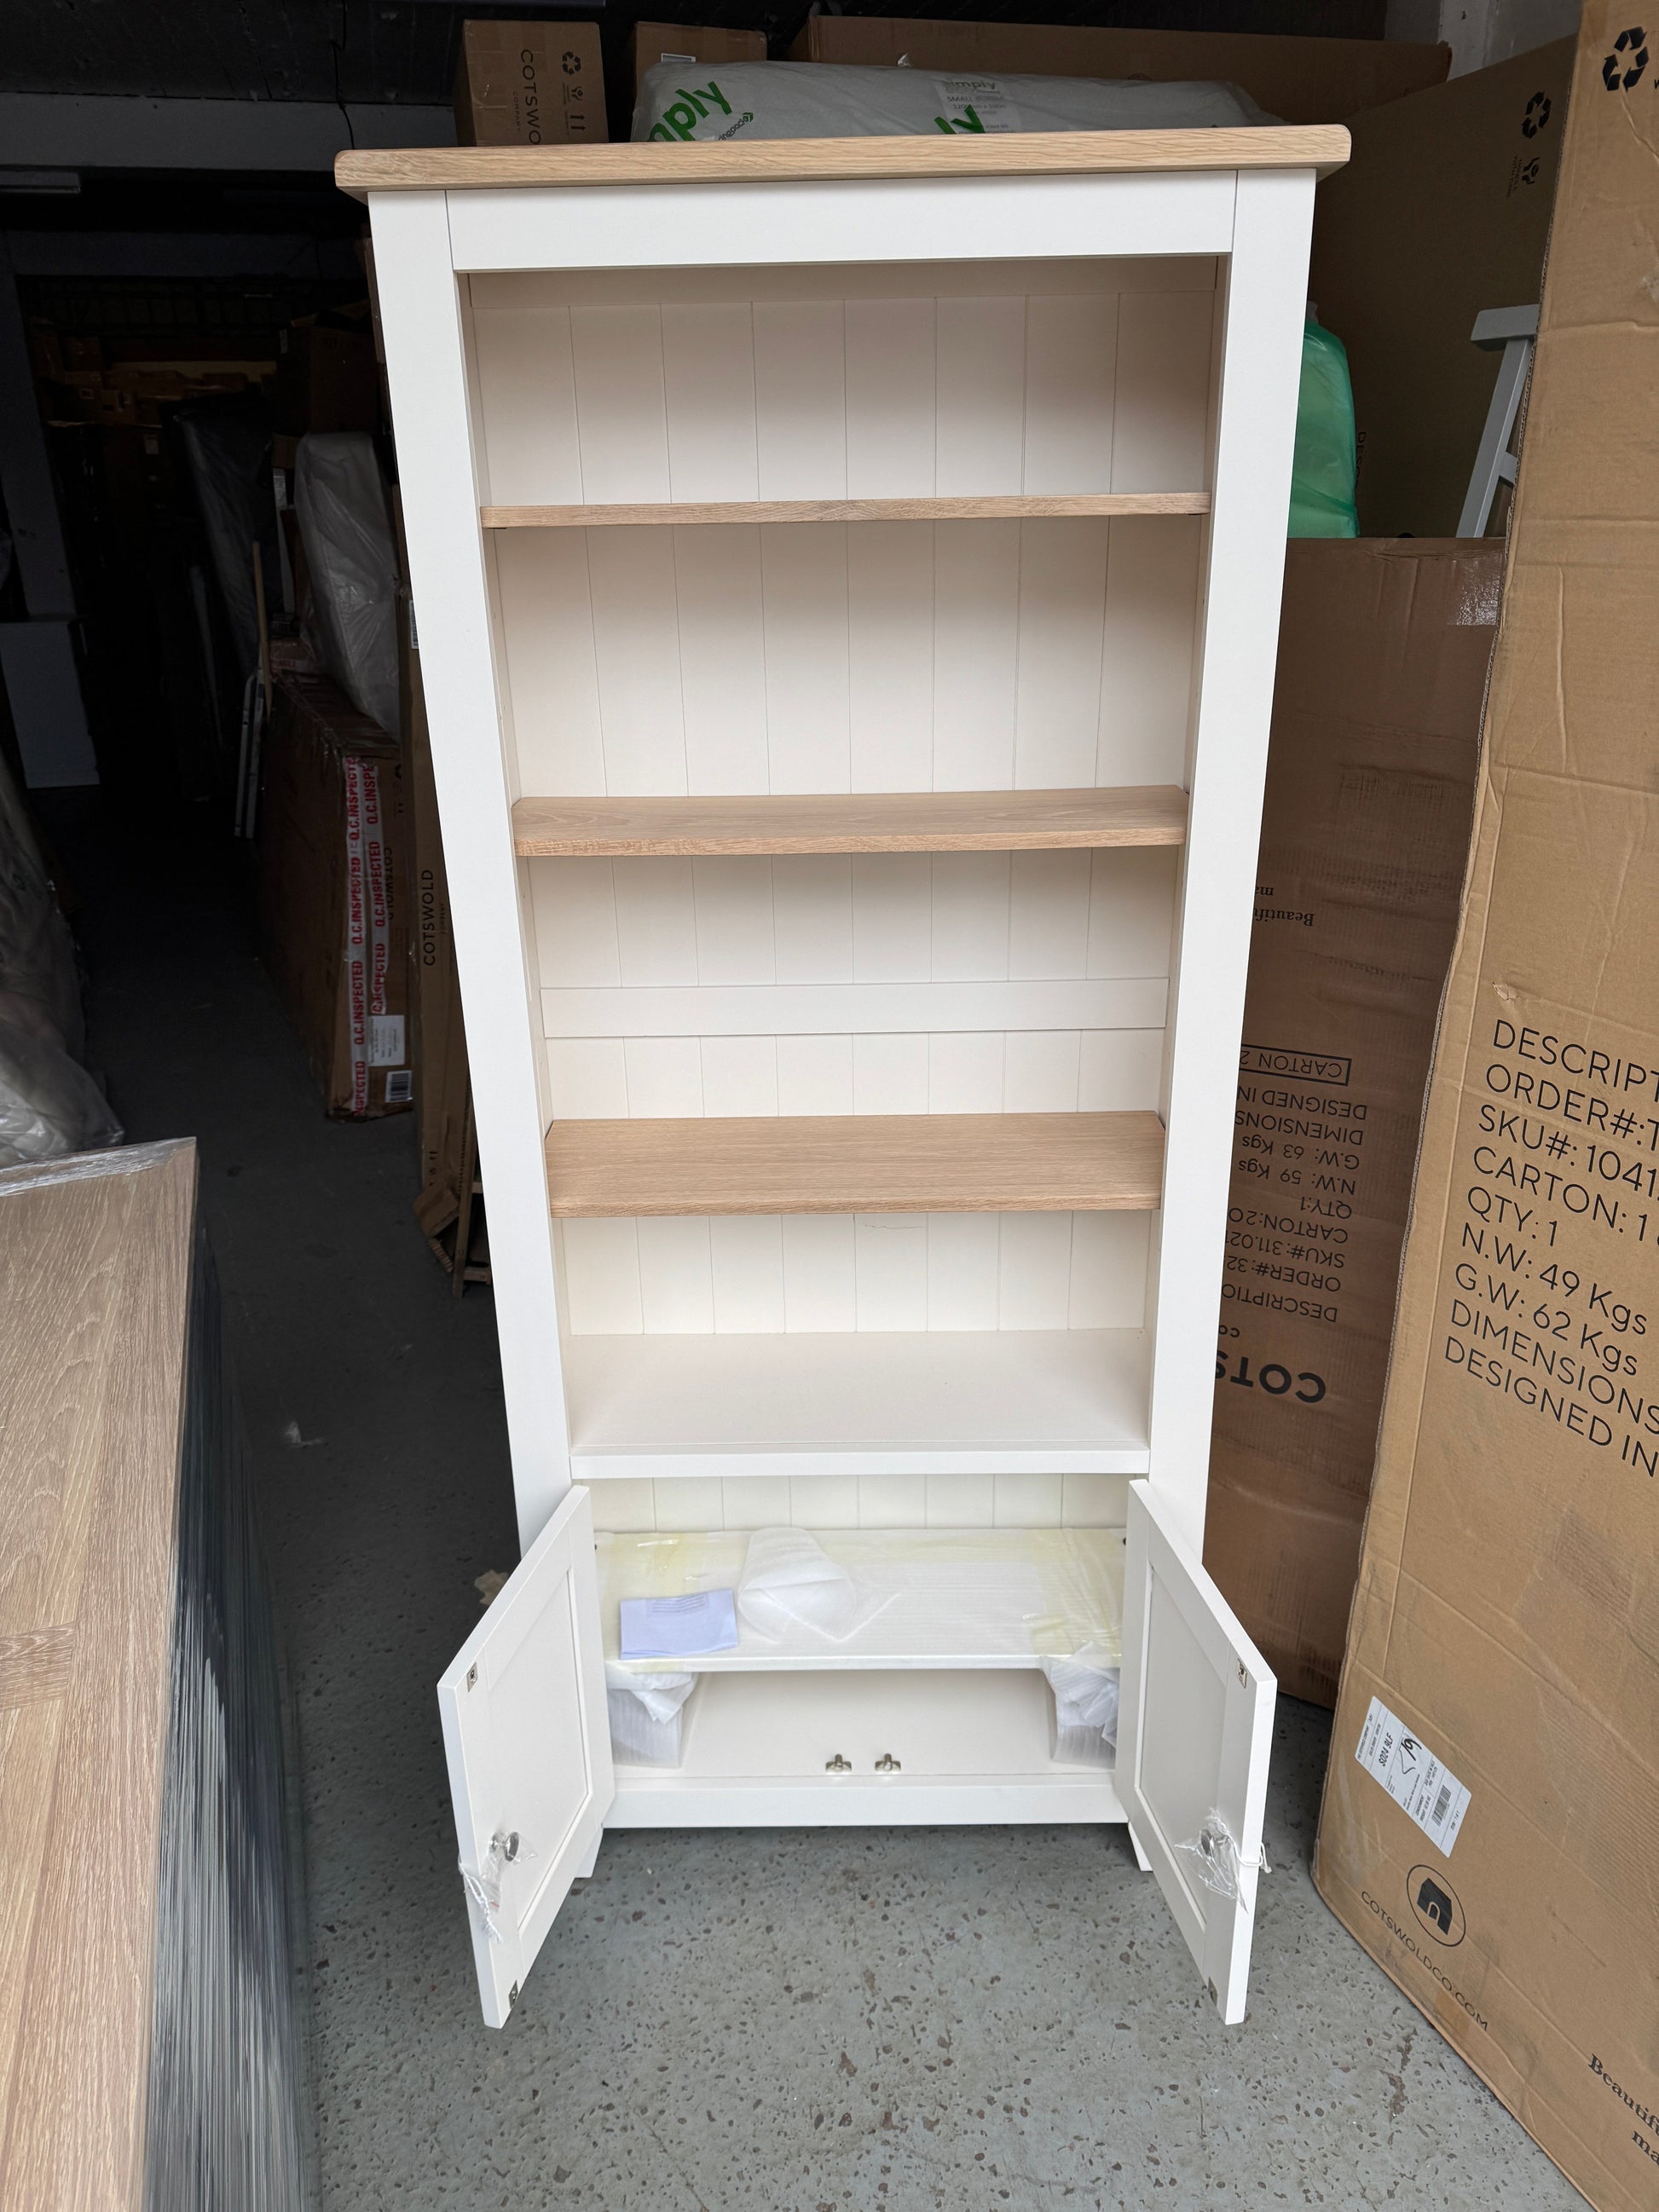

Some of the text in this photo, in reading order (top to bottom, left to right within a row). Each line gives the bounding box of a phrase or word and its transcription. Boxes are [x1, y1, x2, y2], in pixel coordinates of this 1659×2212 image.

[521, 49, 541, 144] COTSWO
[421, 869, 436, 966] COTSWOLD
[1258, 1053, 1342, 1078] CARTON
[1237, 1085, 1367, 1120] DESIGNED IN
[1235, 1111, 1363, 1146] DIMENSIONS
[1242, 1134, 1274, 1155] Kgs
[1239, 1158, 1270, 1179] Kgs
[1283, 1144, 1304, 1159] 63
[1280, 1169, 1302, 1185] 59
[1222, 1284, 1338, 1322] DESCRIPTIO
[1539, 1263, 1581, 1297] 49
[1589, 1282, 1647, 1335] Kgs
[1533, 1302, 1571, 1341] 62
[1580, 1323, 1638, 1376] Kgs
[1451, 1298, 1659, 1435] DIMENSIONS
[1445, 1335, 1659, 1477] DESIGNED IN
[1361, 1891, 1488, 2031] COTSWOLDCO.COM
